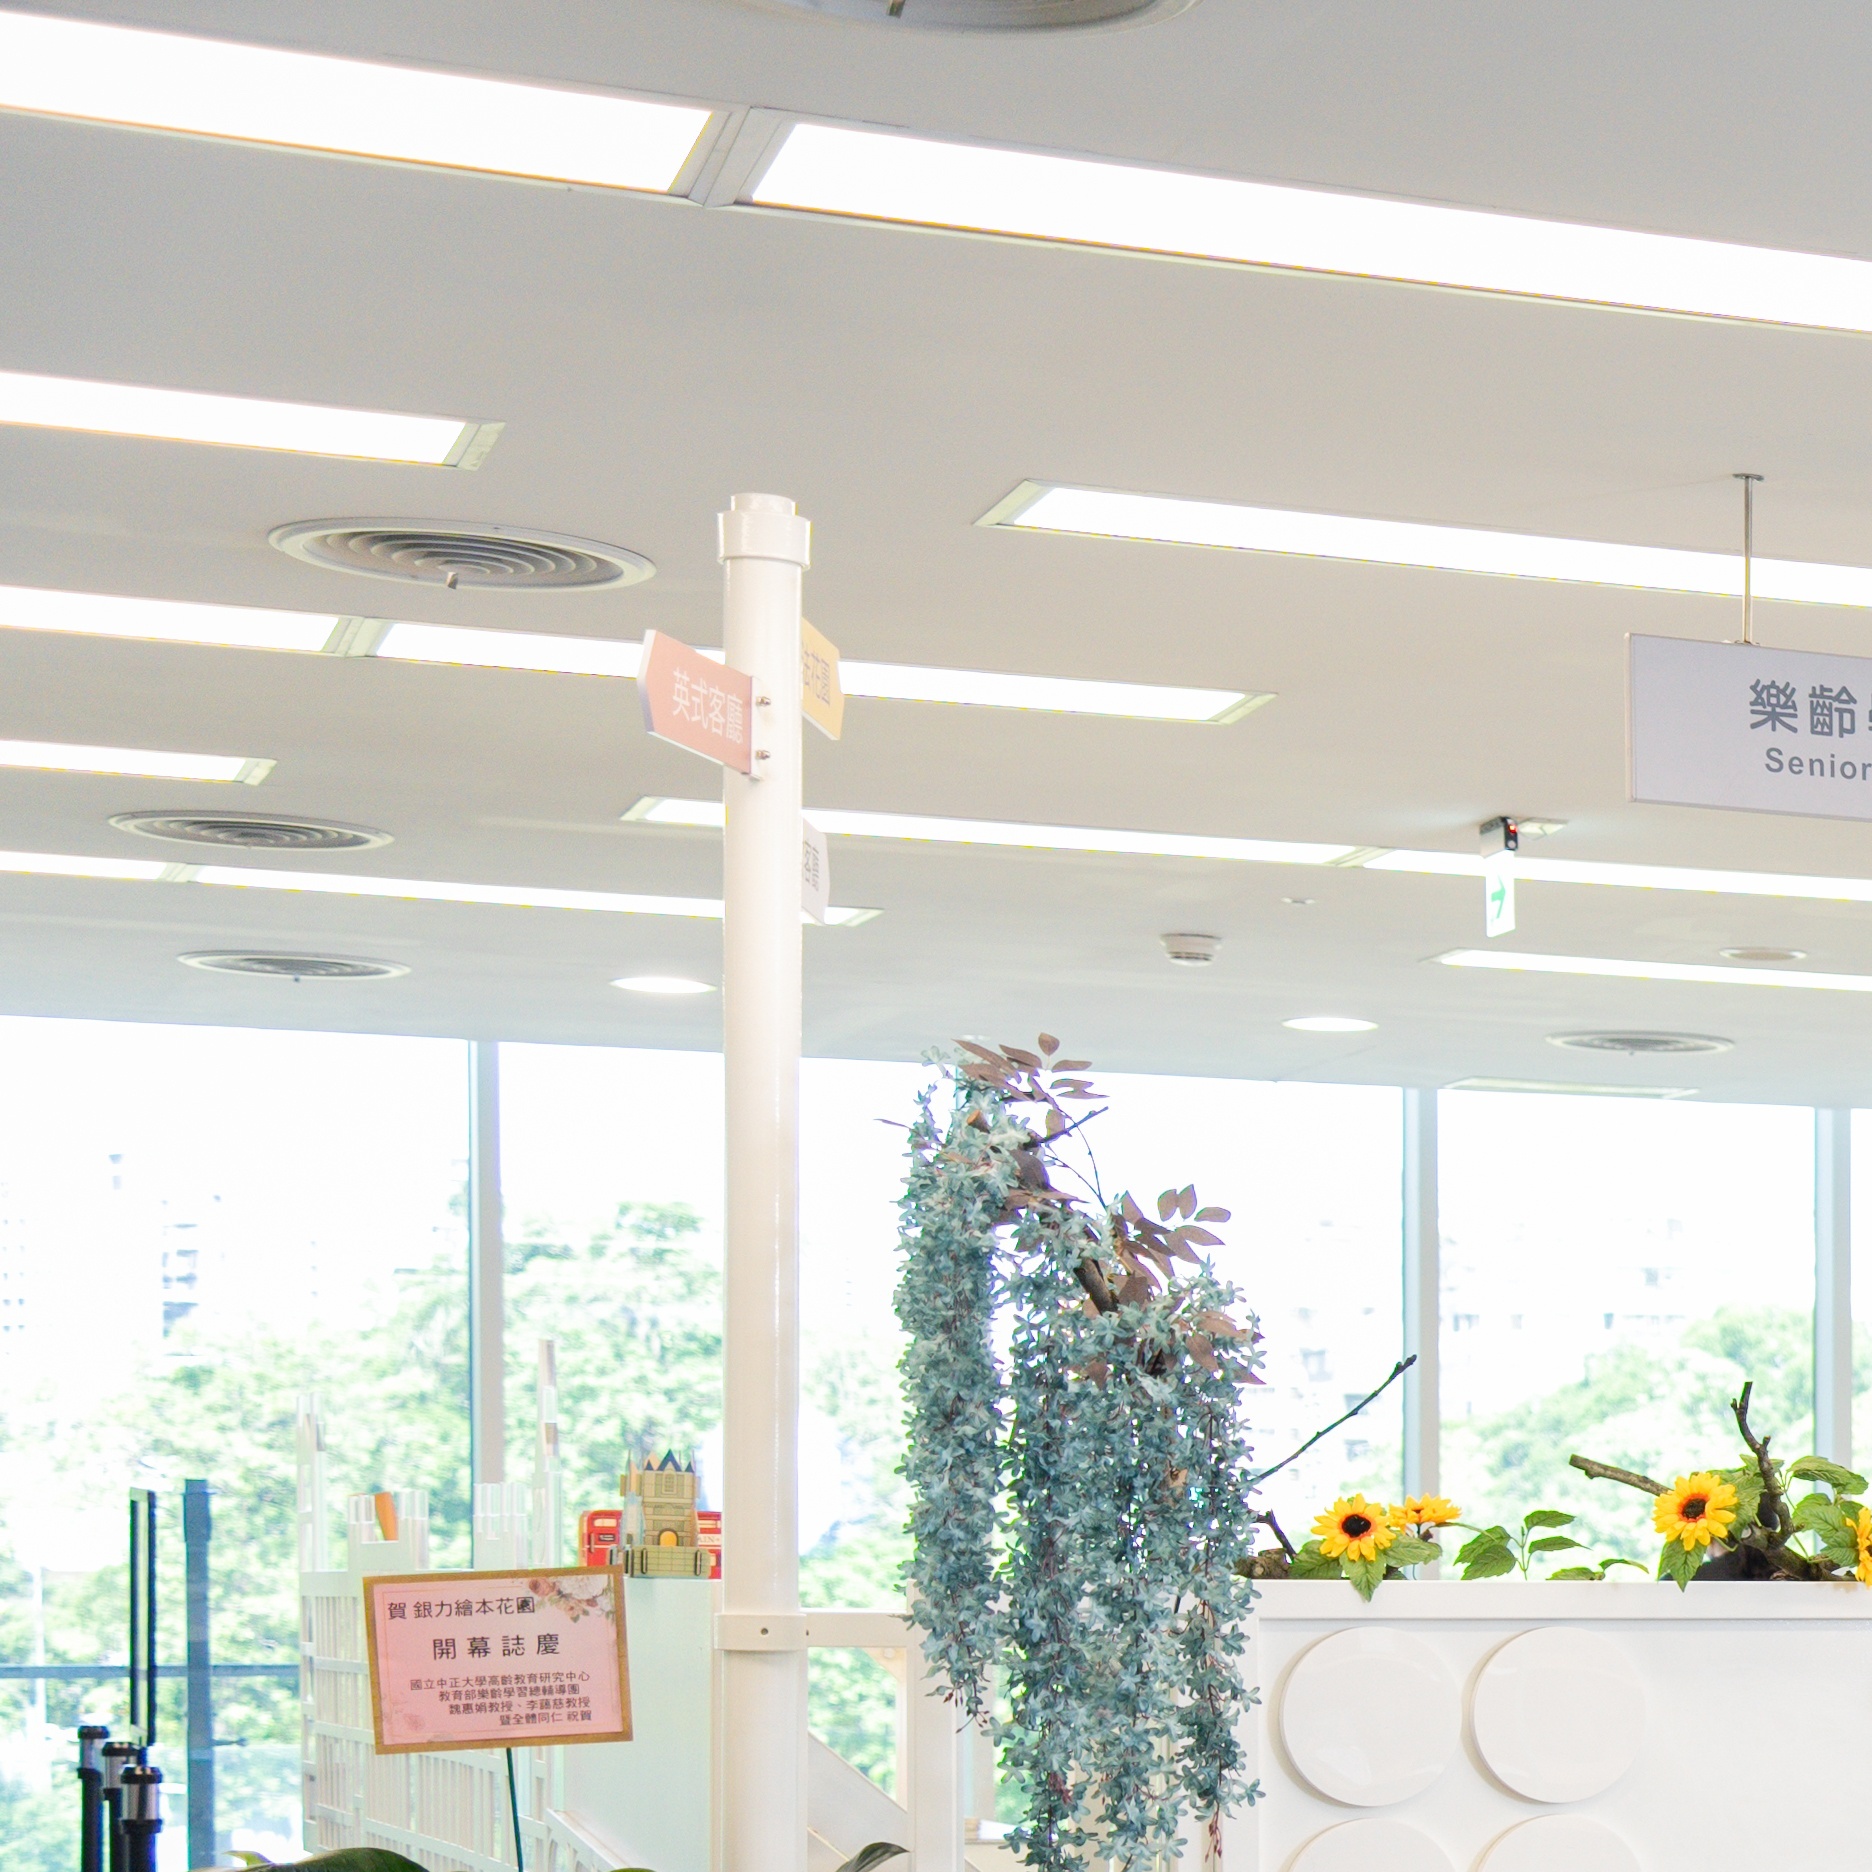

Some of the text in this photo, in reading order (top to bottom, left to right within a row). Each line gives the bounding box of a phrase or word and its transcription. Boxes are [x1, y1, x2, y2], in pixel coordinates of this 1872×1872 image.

[671, 666, 744, 745] 英式客廳
[1764, 746, 1872, 782] Senior
[388, 1596, 535, 1620] 賀 銀力繪本花園
[432, 1633, 560, 1660] 開幕誌慶
[410, 1671, 590, 1690] 國立中正大學高齡教育研究中心
[439, 1683, 580, 1702] 教育部樂齡學習總輔導團
[499, 1710, 592, 1726] 暨全體同仁 祝賀
